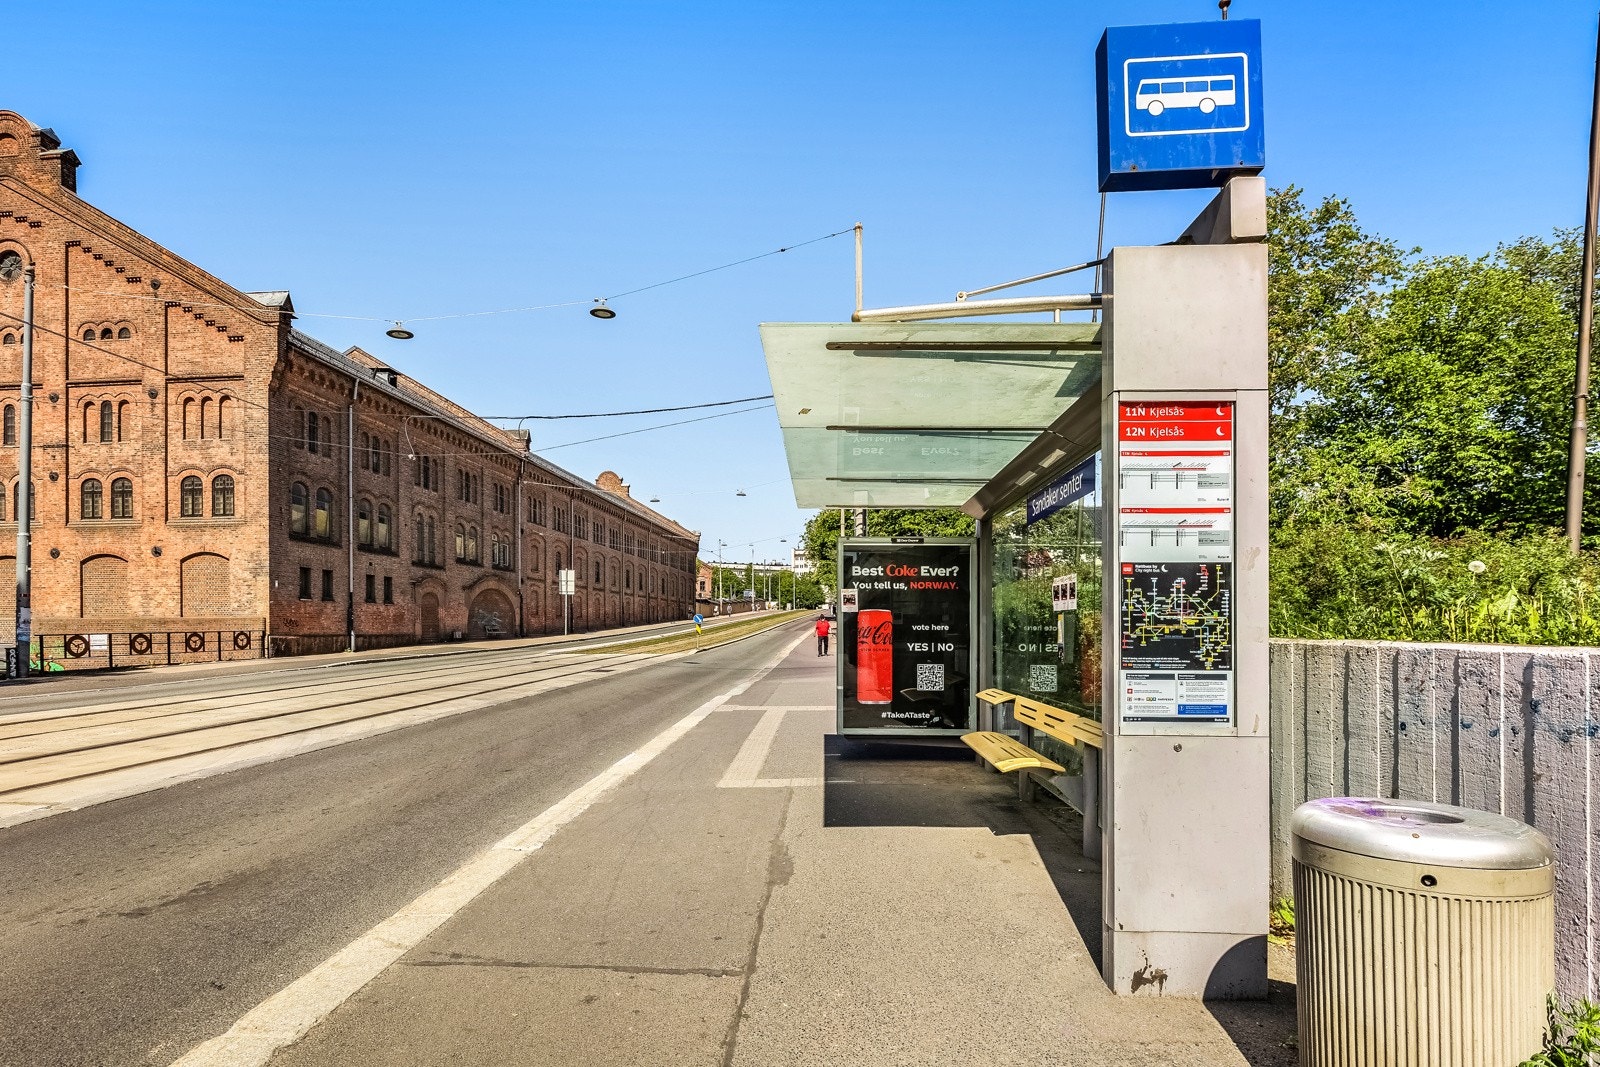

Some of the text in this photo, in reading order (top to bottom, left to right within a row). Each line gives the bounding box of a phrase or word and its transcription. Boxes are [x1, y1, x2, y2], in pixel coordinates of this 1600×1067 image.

[1125, 406, 1184, 418] 11N Kjelsås
[1125, 426, 1184, 438] 12N Kjelsås
[1032, 473, 1083, 516] Sandaker senter
[852, 564, 960, 577] Best Coke Ever?
[852, 581, 959, 591] You tell us, NORWAY.
[907, 642, 929, 652] YES
[937, 642, 954, 652] NO
[881, 711, 931, 720] #TakeATaste
